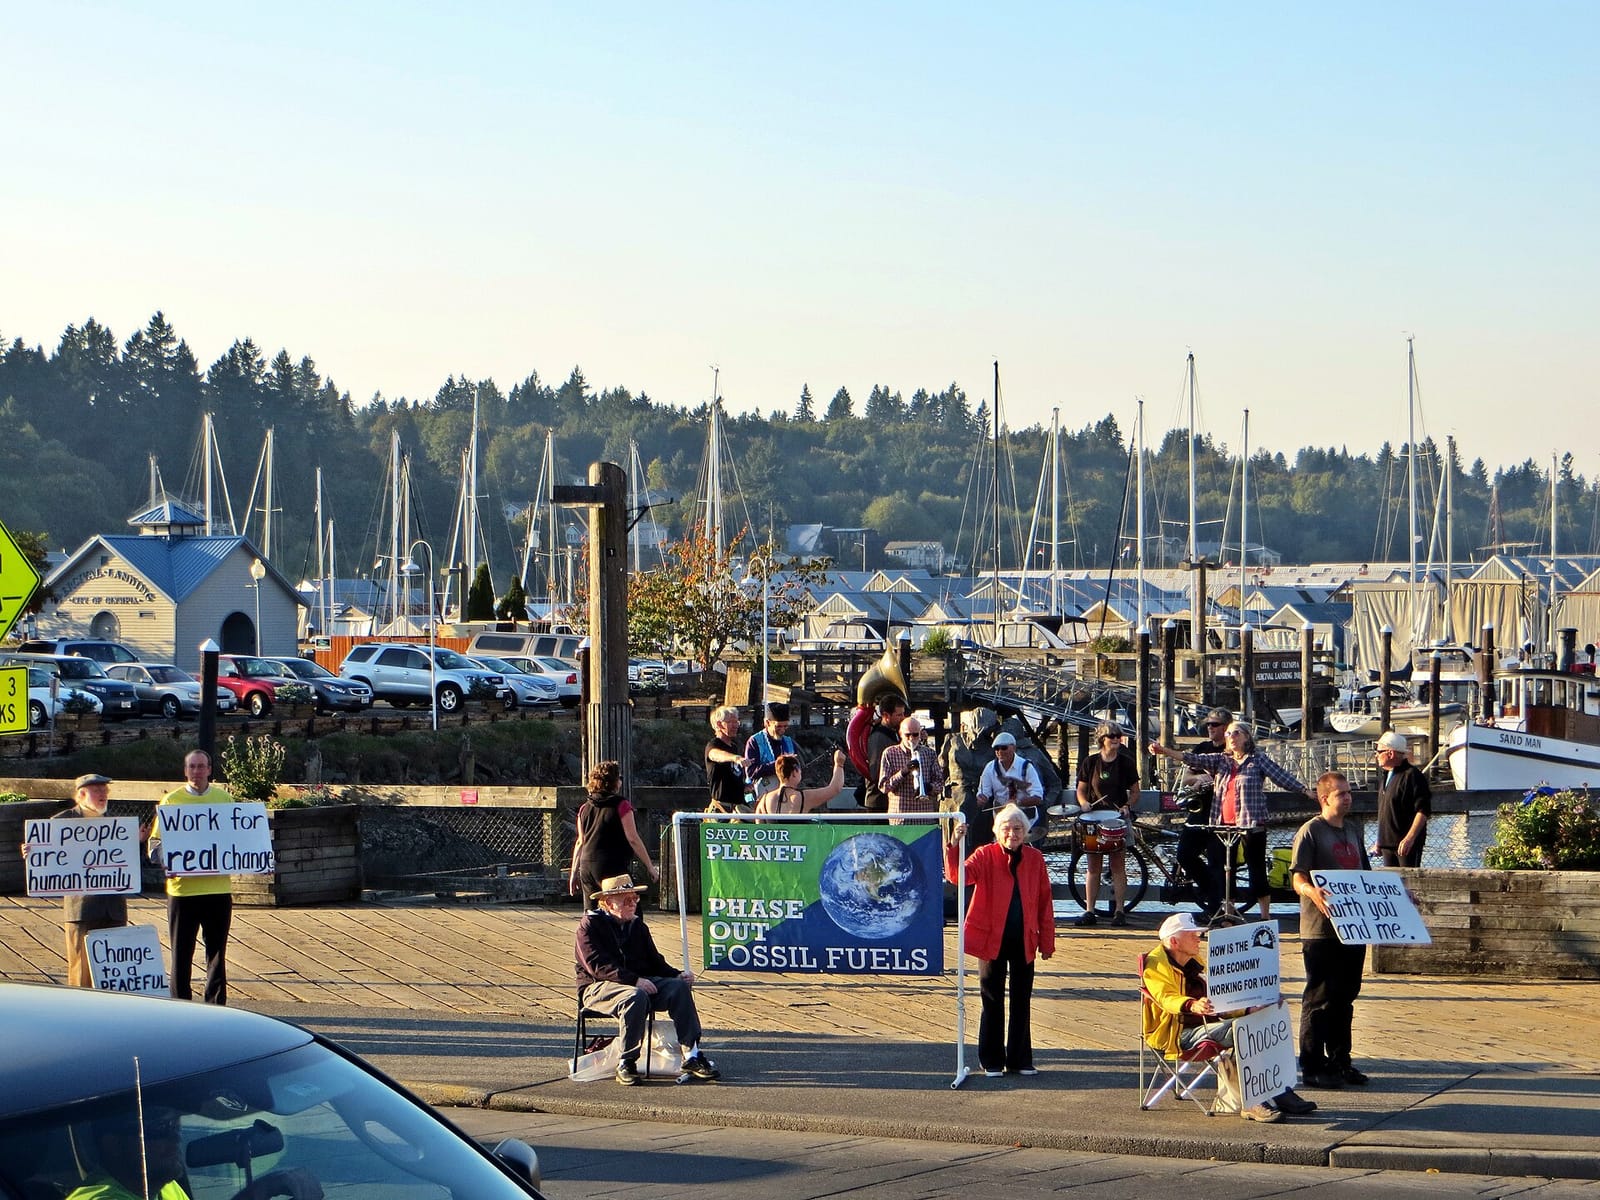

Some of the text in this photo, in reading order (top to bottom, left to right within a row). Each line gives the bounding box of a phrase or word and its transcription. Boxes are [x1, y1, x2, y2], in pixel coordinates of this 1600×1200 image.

[7, 676, 16, 697] 3
[1499, 733, 1542, 749] SAND MAN
[159, 807, 265, 832] Work for
[27, 819, 129, 846] All people
[705, 828, 790, 842] SAVE OUR
[30, 847, 126, 867] are one
[167, 842, 274, 873] real change
[706, 843, 807, 862] PLANET
[28, 867, 131, 892] human family
[1314, 874, 1402, 900] Peace begins
[707, 898, 804, 919] PHASE
[1328, 897, 1398, 921] with you
[709, 921, 770, 942] OUT
[1337, 918, 1416, 941] and me.
[92, 939, 155, 965] Change
[709, 943, 929, 971] FOSSIL FUELS
[1209, 940, 1249, 957] HOW IS THE
[102, 965, 137, 978] to a
[1209, 957, 1260, 977] WAR ECONOMY
[101, 974, 169, 992] PEACEFUL
[1209, 974, 1278, 996] WORKING FOR YOU?
[1236, 1018, 1289, 1061] Choose
[1242, 1063, 1283, 1101] Peace
